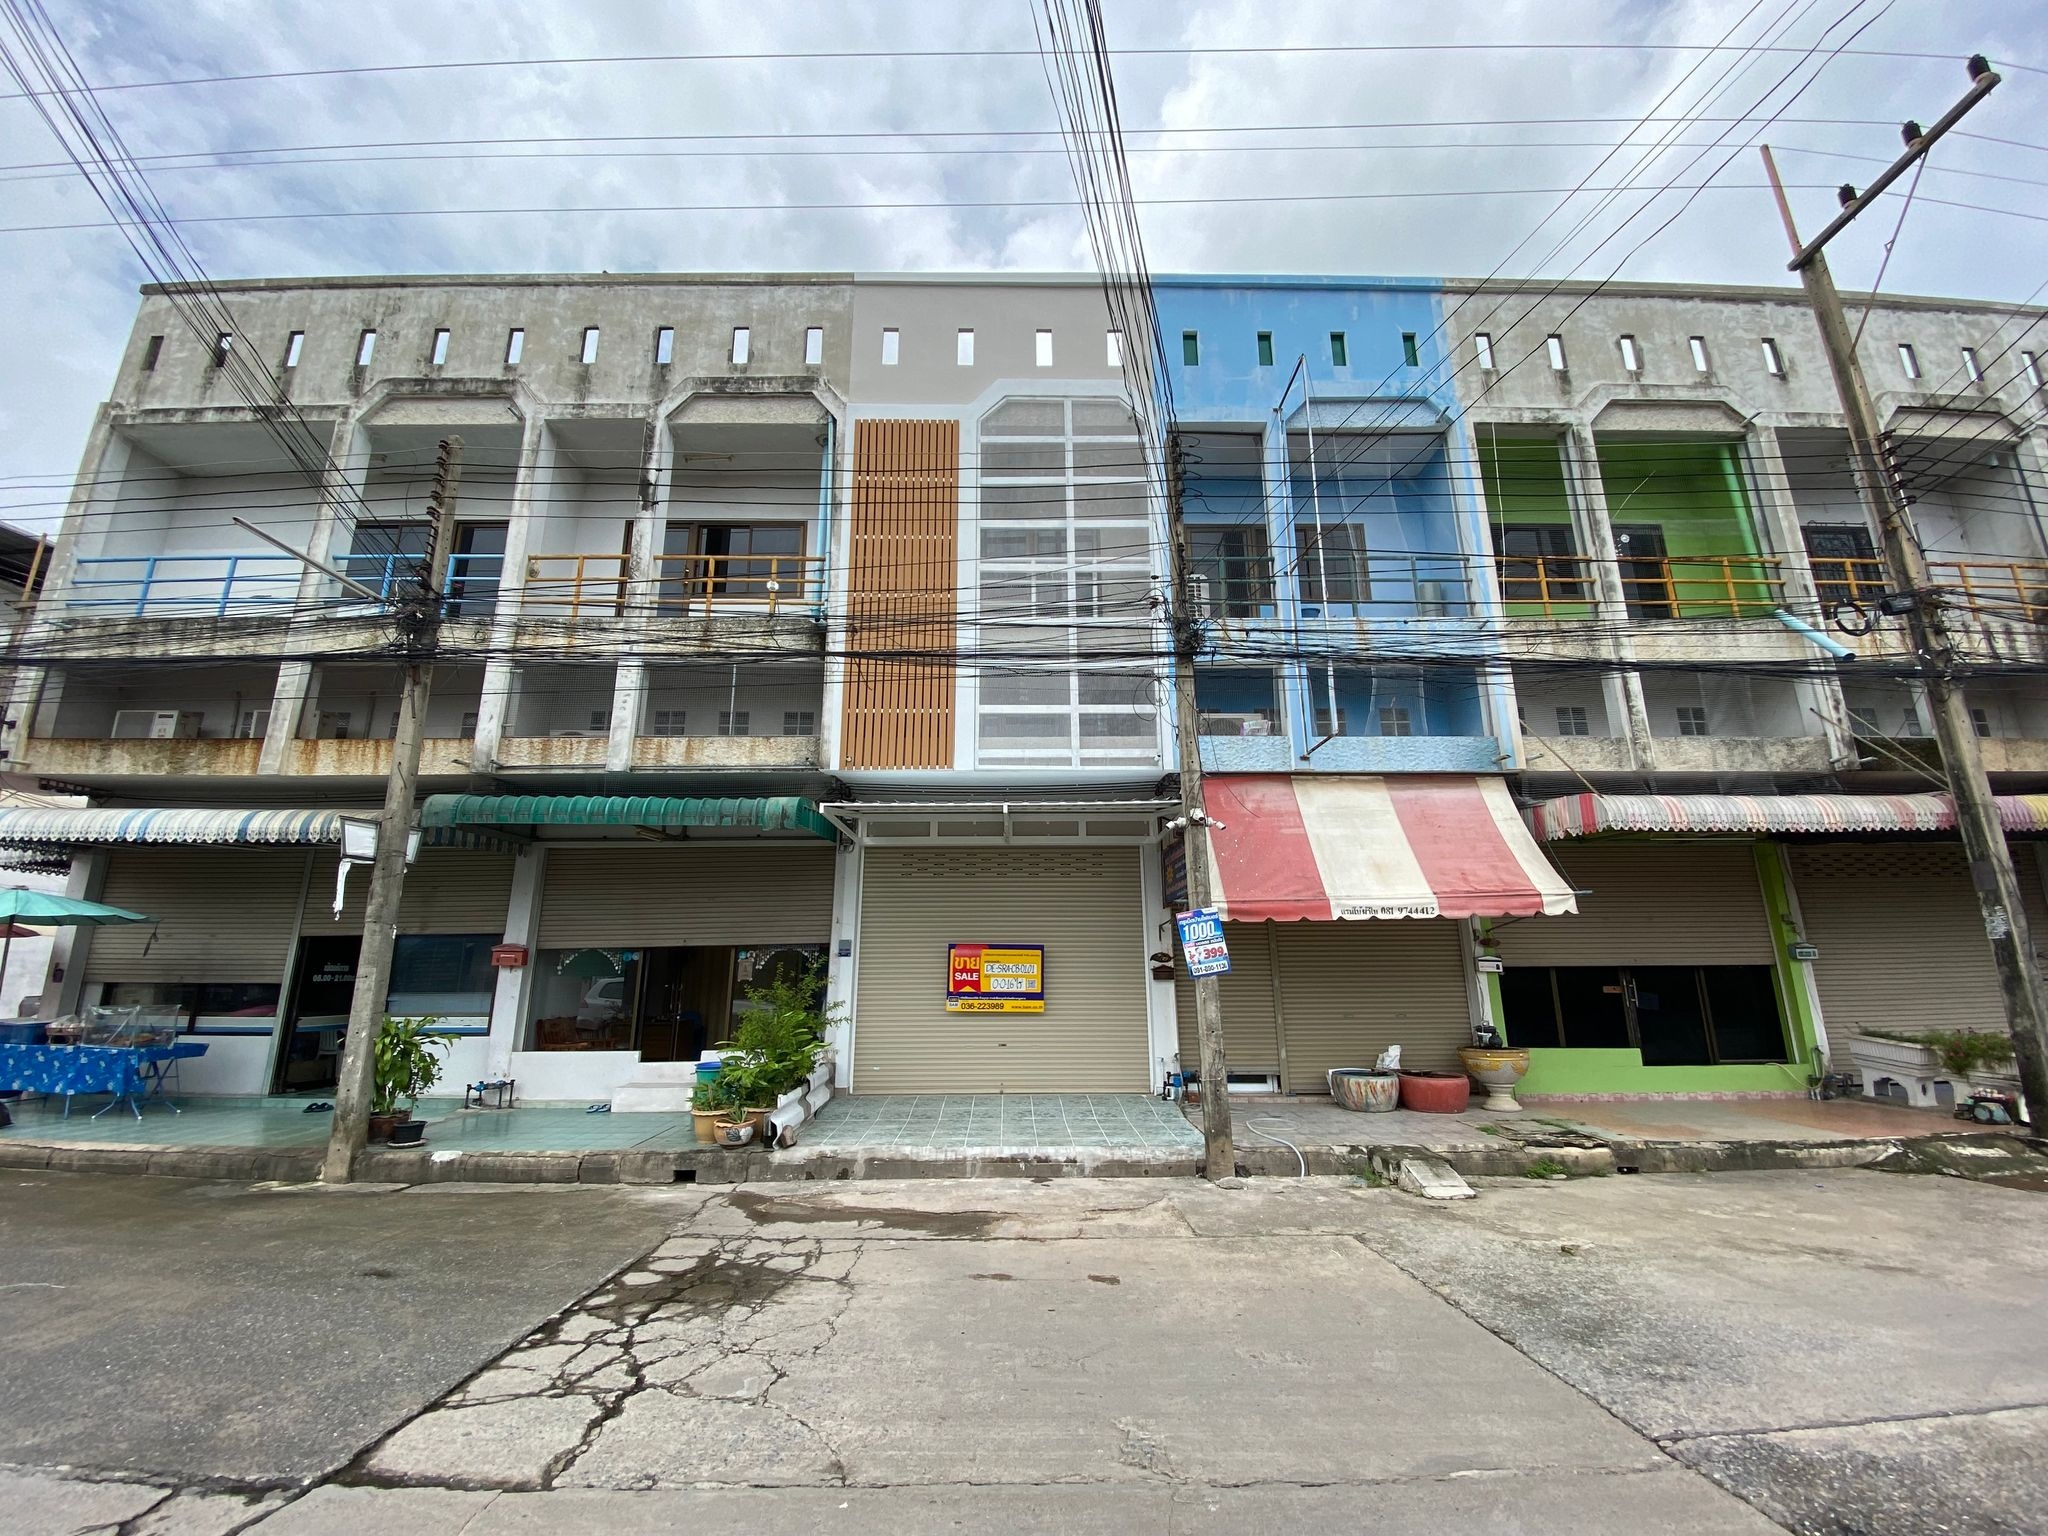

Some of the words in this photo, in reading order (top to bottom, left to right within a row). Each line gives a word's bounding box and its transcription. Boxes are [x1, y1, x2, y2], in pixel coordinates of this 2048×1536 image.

[1380, 907, 1394, 915] 081
[1397, 907, 1435, 915] 9744412
[1183, 921, 1215, 941] 1000
[954, 957, 980, 969] ขาย
[954, 972, 979, 981] SALE
[961, 1002, 1005, 1010] 036-223989
